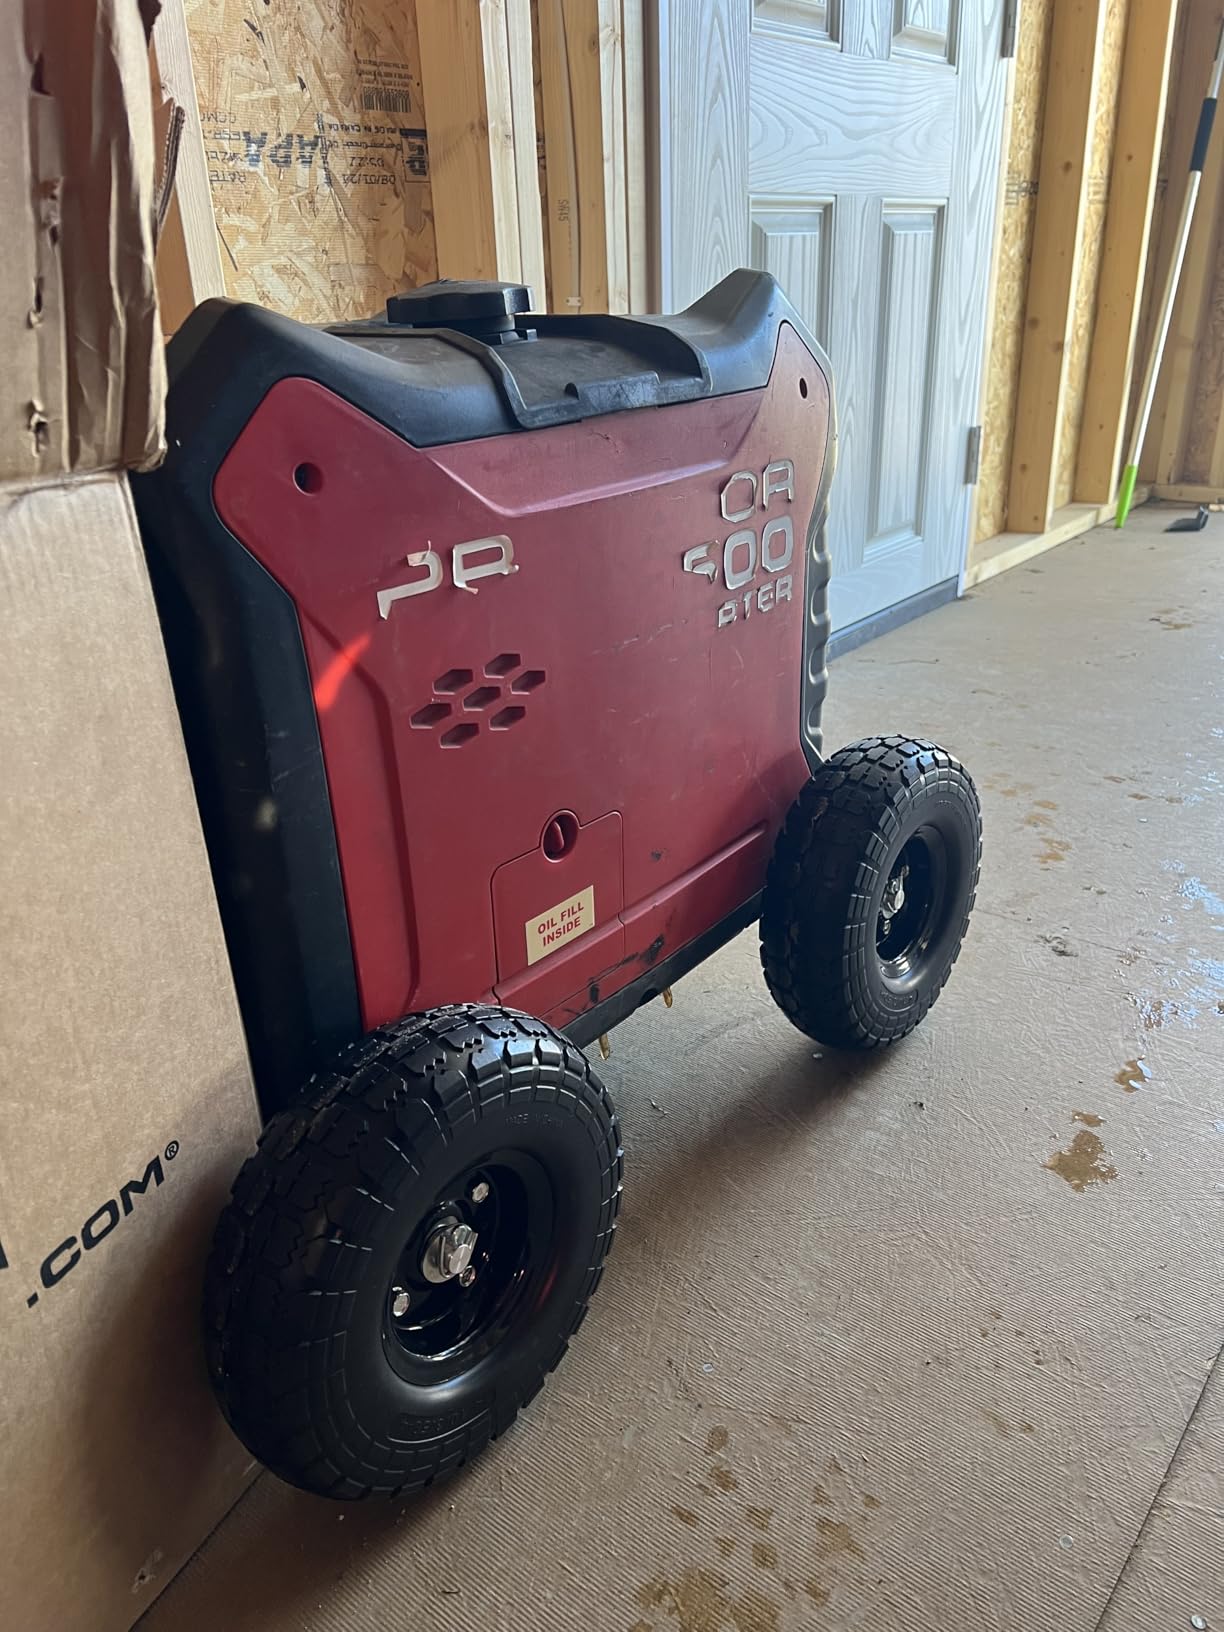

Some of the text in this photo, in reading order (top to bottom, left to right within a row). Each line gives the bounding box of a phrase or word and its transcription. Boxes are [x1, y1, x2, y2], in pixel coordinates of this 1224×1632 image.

[242, 131, 320, 168] APA
[538, 902, 584, 935] OIL FILL
[543, 917, 581, 947] INSIDE
